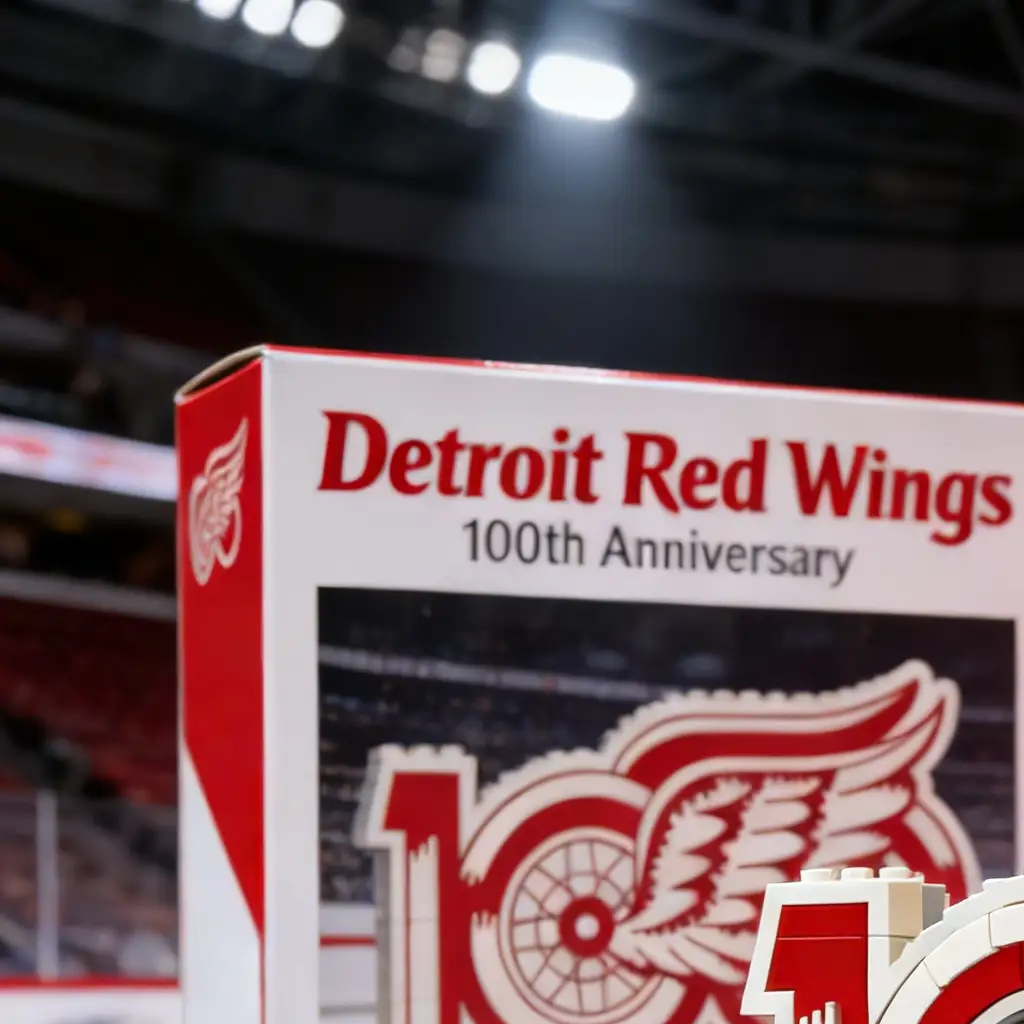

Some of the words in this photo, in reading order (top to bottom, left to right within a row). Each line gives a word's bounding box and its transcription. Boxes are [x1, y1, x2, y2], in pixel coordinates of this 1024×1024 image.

[316, 410, 605, 505] Detroit
[622, 431, 769, 515] Red
[784, 440, 1014, 548] Wings
[463, 519, 585, 566] 100th
[600, 525, 853, 586] Anniversary
